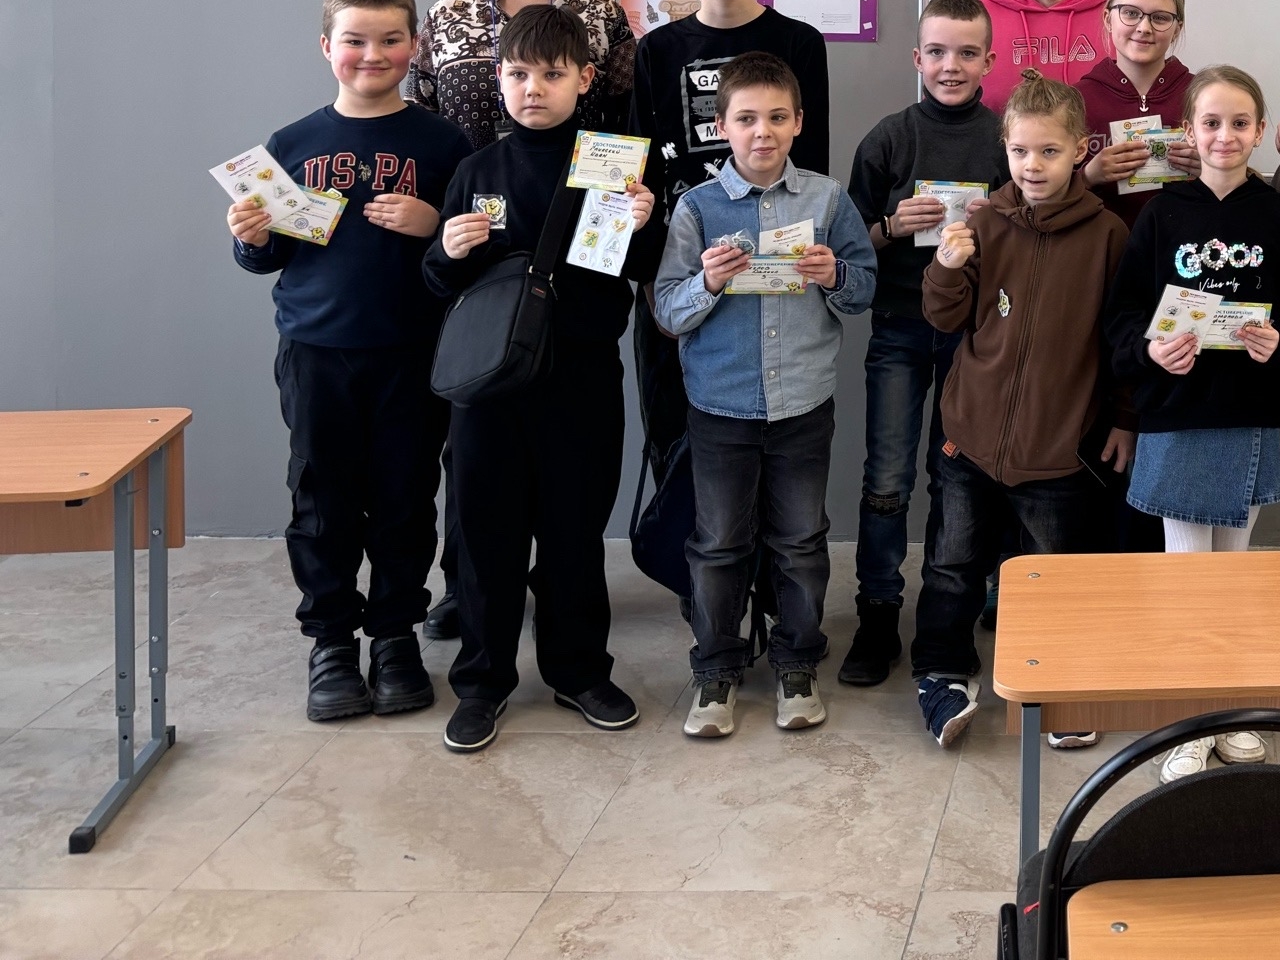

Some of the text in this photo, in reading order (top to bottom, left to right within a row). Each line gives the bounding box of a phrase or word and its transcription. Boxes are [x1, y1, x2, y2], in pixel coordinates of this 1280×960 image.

[1012, 34, 1097, 65] FILA
[304, 152, 356, 192] US
[372, 152, 418, 198] PA
[1174, 238, 1264, 279] GOOD
[1199, 277, 1240, 292] Vibes only
